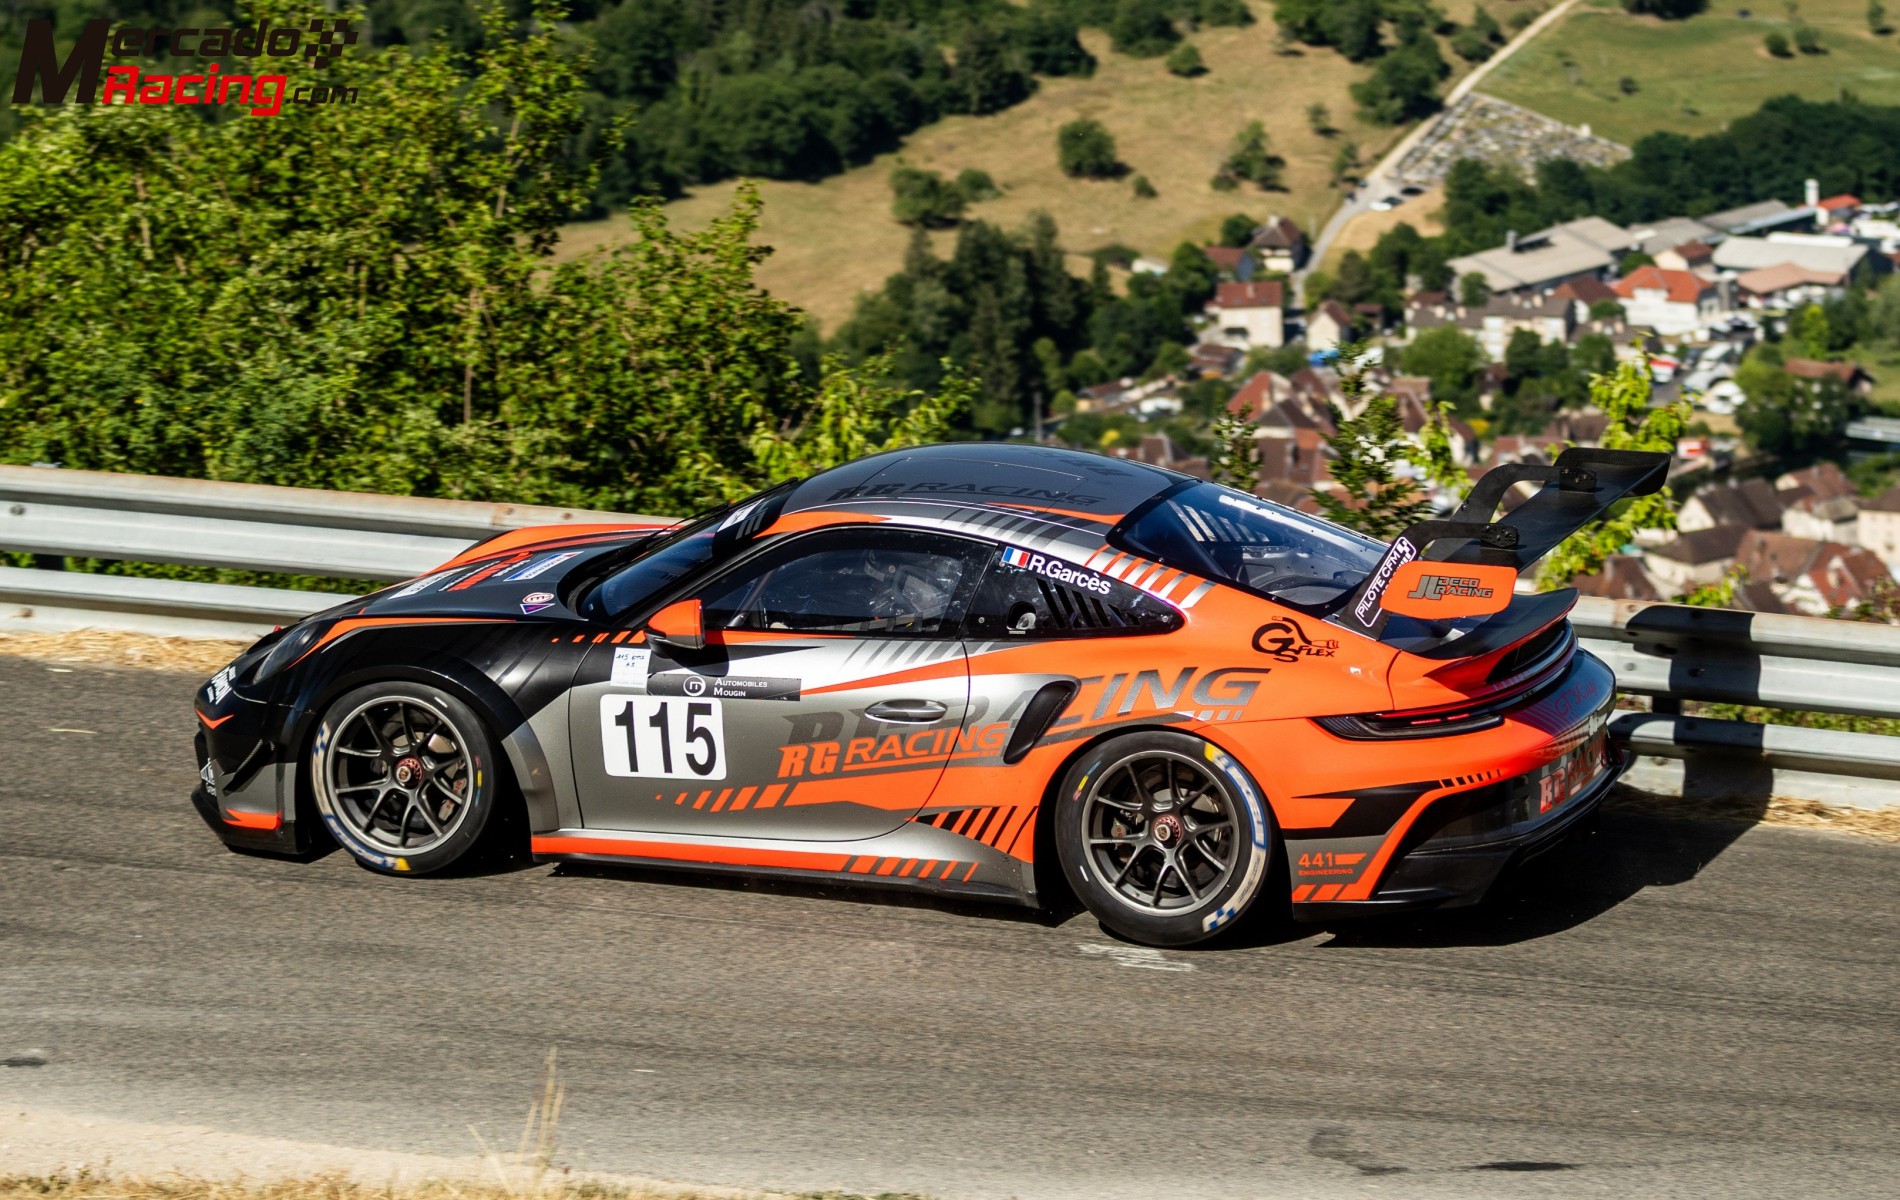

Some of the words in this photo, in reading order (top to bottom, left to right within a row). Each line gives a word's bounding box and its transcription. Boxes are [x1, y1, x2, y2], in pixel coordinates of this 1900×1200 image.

[907, 482, 1107, 506] RACING
[1028, 554, 1111, 595] R.Garcès
[1356, 575, 1386, 618] PILOTE
[1381, 552, 1401, 578] CFM
[1435, 586, 1493, 598] RACING
[1299, 645, 1336, 658] FLEX
[615, 701, 717, 776] 115
[777, 740, 841, 778] RG
[844, 722, 1009, 763] RACING
[1298, 851, 1333, 868] 441
[1298, 867, 1353, 876] ENGINEERING
